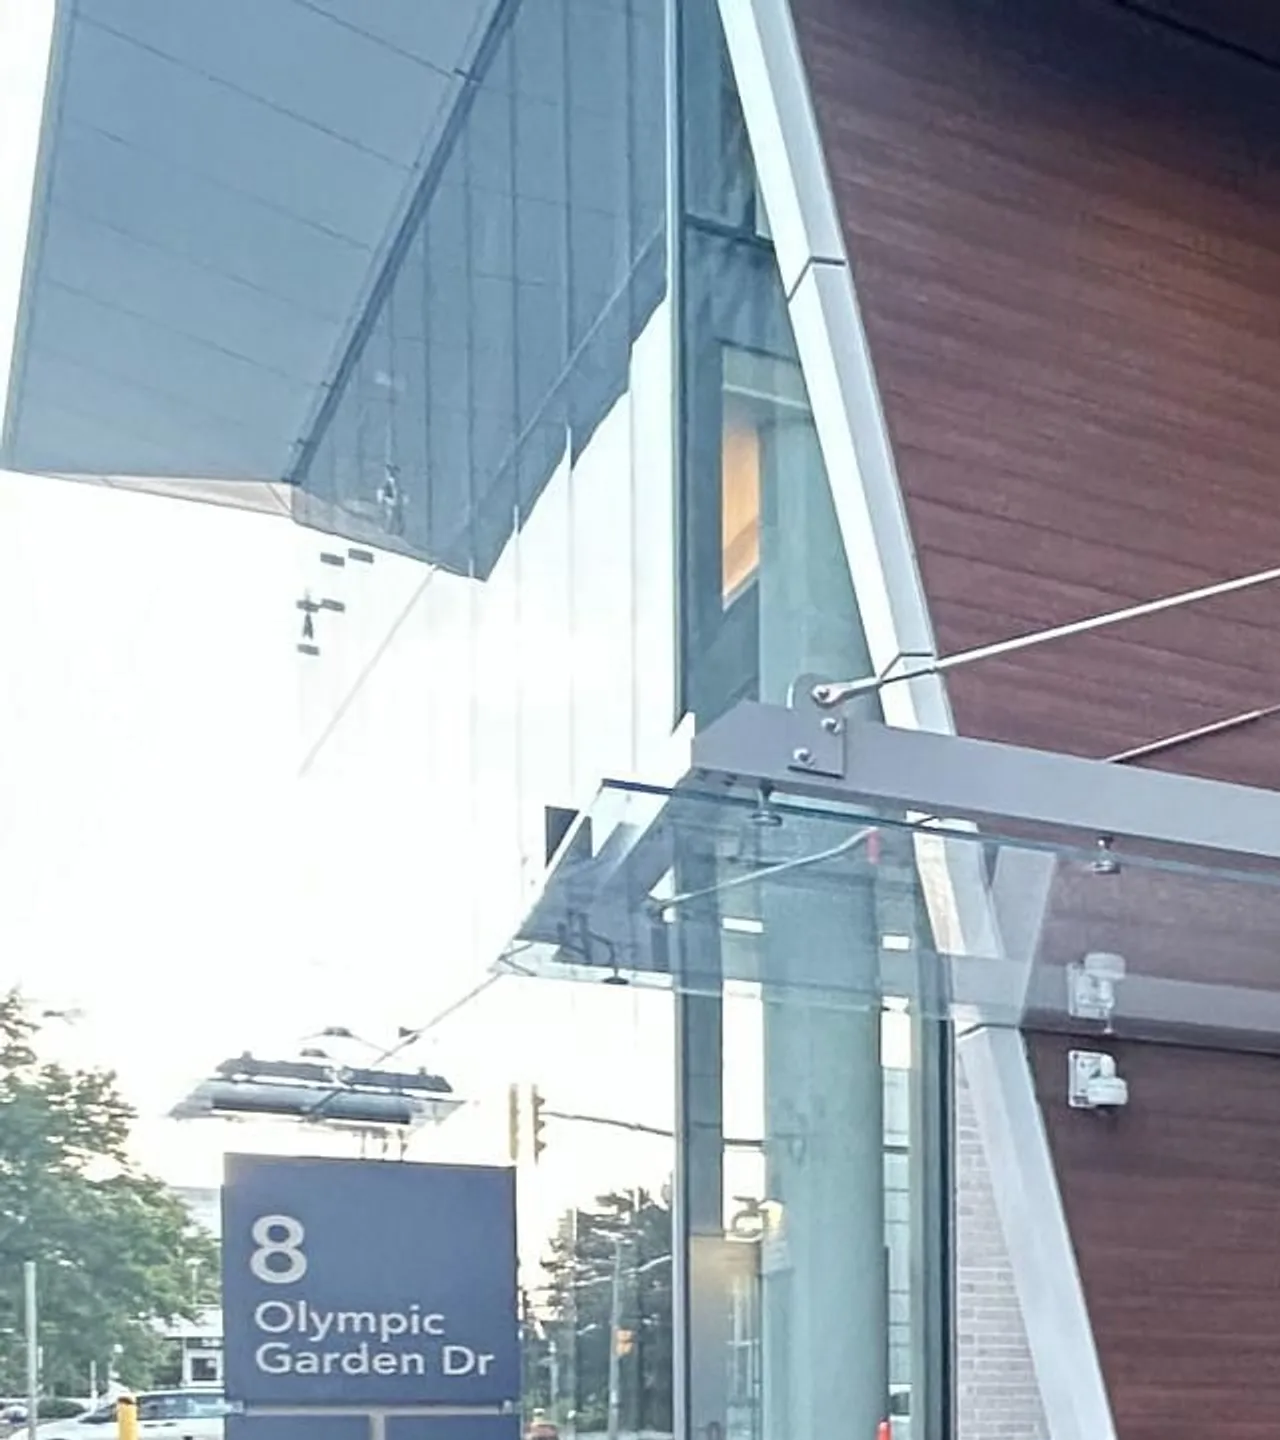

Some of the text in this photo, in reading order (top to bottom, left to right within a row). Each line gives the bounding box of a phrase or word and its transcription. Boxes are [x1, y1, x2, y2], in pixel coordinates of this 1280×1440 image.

[250, 1214, 307, 1284] 8
[254, 1300, 445, 1342] Olympic
[255, 1342, 494, 1375] Garden Dr
